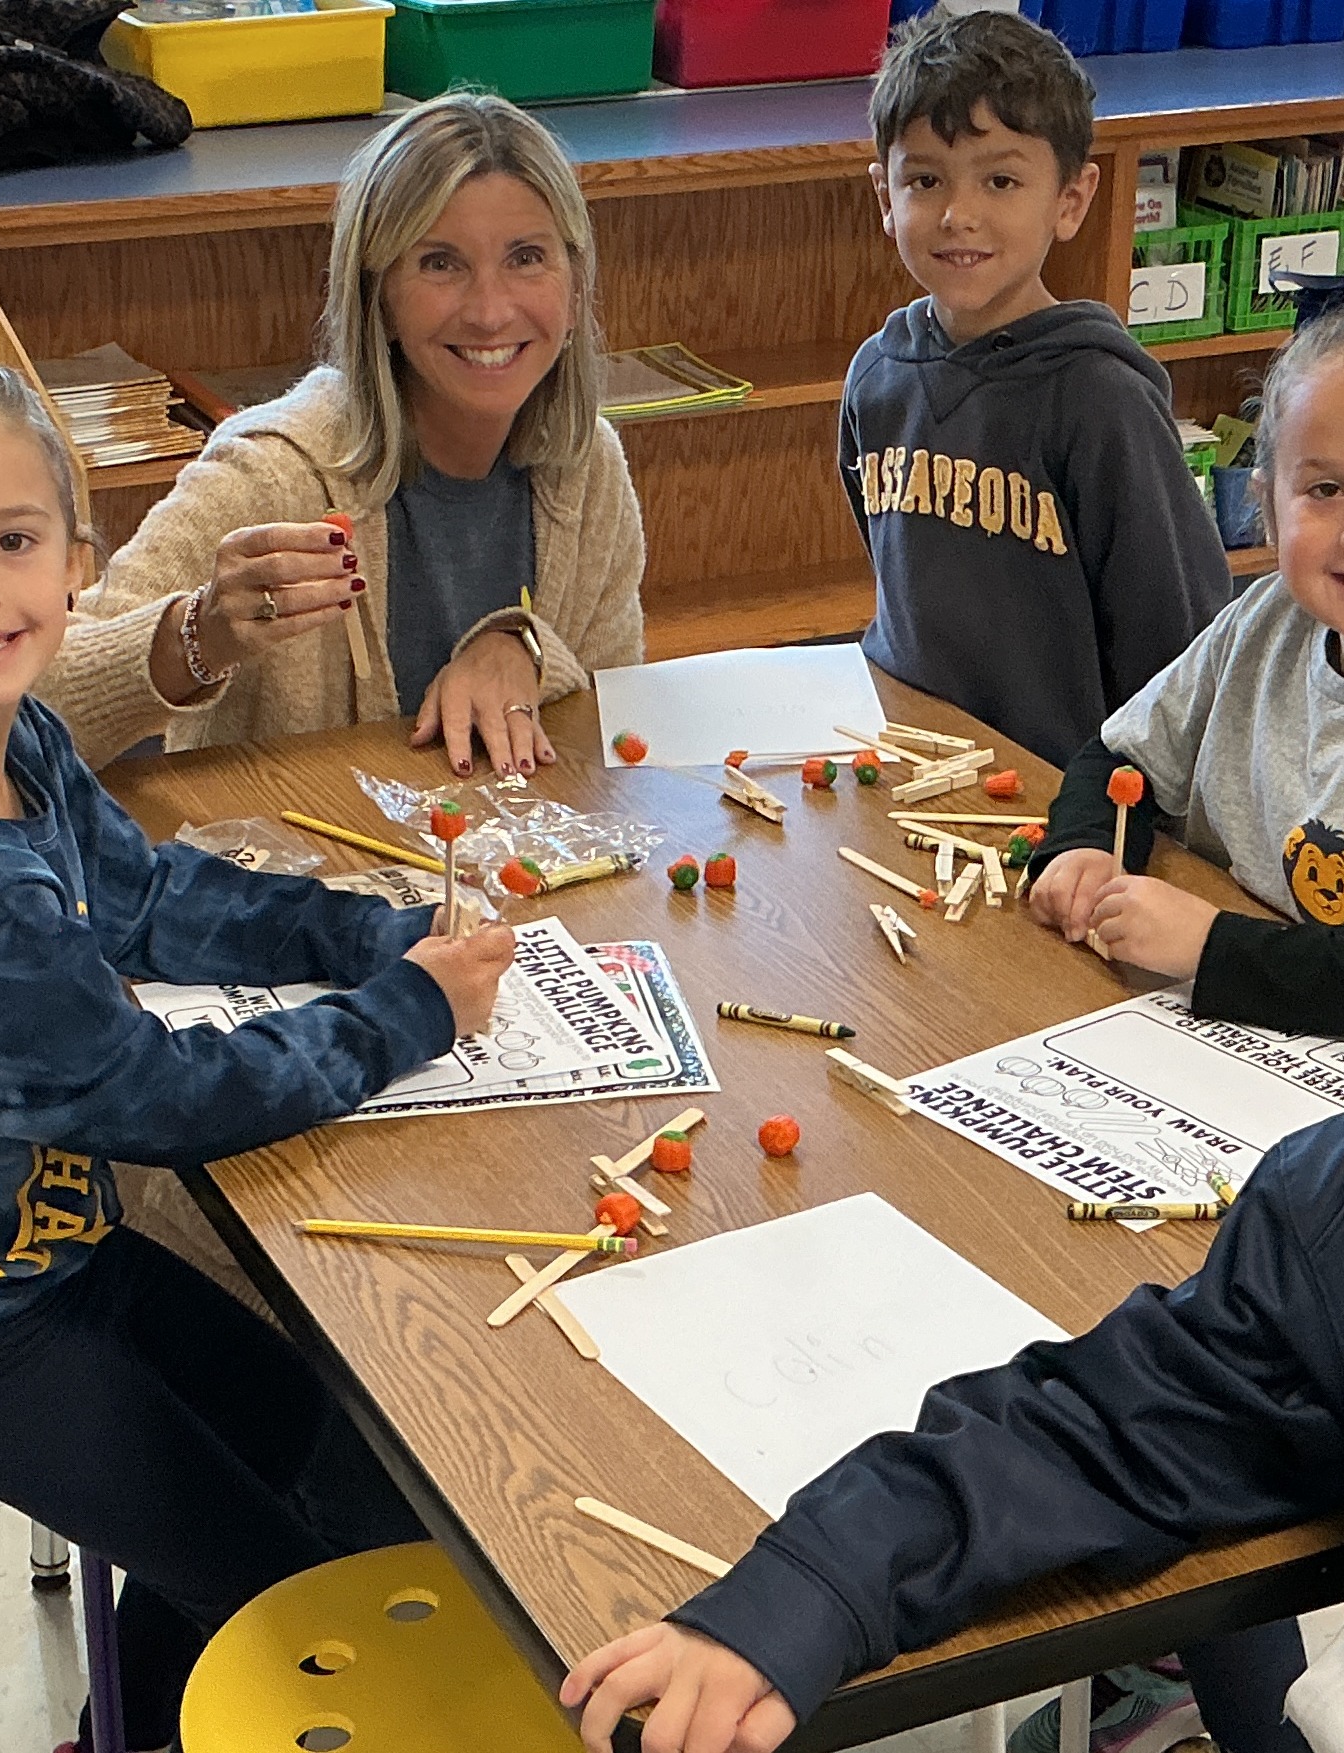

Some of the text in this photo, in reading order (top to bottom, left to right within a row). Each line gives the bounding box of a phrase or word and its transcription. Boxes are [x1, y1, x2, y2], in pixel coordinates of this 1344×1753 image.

[1300, 240, 1318, 269] F
[1164, 279, 1189, 311] D
[521, 928, 549, 939] 5
[530, 938, 586, 980] LITTLE
[534, 978, 620, 1055] CHALLENGE
[565, 978, 655, 1055] PUMPKINS
[1174, 1017, 1206, 1034] TO
[1203, 1028, 1251, 1054] ABLE
[1247, 1049, 1297, 1075] YOU
[1267, 1047, 1310, 1070] THE
[1046, 1055, 1243, 1155] DRAW YOUR PLAN:
[907, 1083, 1137, 1204] LITTLE PUMPKINS
[932, 1081, 1167, 1200] STEM CHALLENGE
